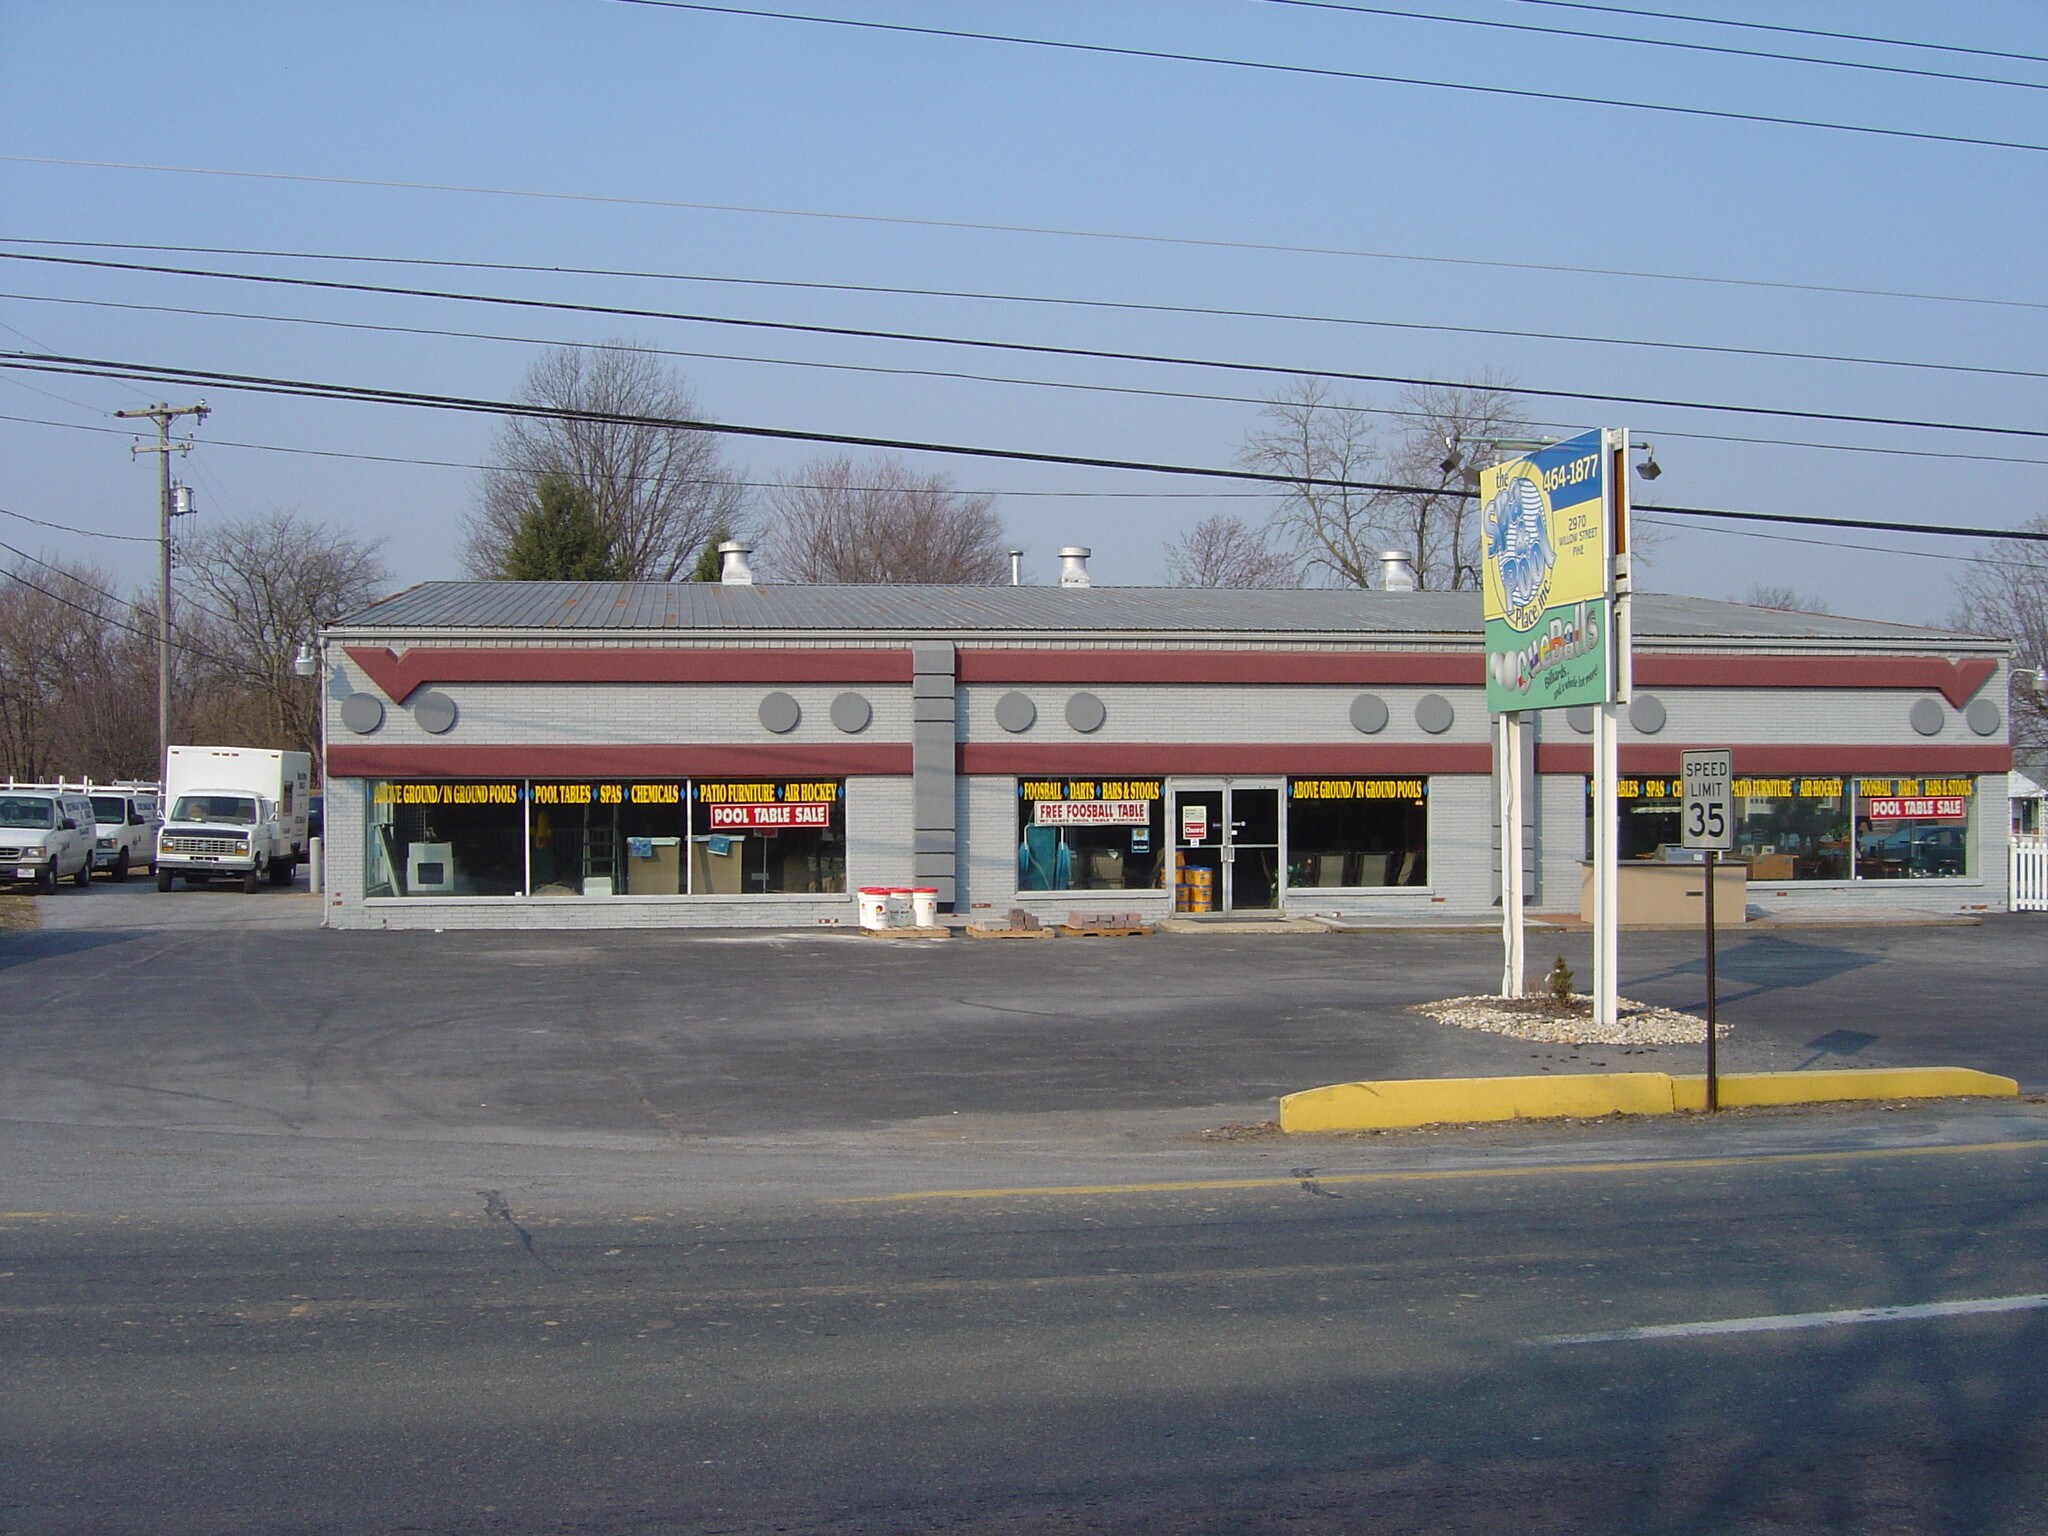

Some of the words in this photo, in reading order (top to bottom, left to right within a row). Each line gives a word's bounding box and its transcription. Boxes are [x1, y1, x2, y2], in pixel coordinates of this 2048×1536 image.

[1495, 466, 1509, 489] the
[1543, 453, 1599, 492] 464-1877
[1568, 514, 1587, 532] 2970
[1559, 533, 1578, 547] WILLOW
[1579, 527, 1598, 542] STREET
[1572, 544, 1585, 557] PIKE
[1686, 761, 1727, 777] SPEED
[453, 784, 488, 804] GROUND
[489, 784, 517, 804] POOLS
[534, 784, 559, 804] POOL
[559, 784, 591, 804] TABLES
[600, 784, 622, 804] SPAS
[631, 784, 679, 804] CHEMICALS
[700, 784, 727, 803] PATIO
[728, 783, 775, 803] FURNITURE
[783, 783, 800, 802] AIR
[800, 783, 837, 802] HOCKEY
[1024, 782, 1062, 800] FOOSBALL
[1069, 782, 1095, 800] DARTS
[1102, 782, 1122, 800] BARS
[1123, 782, 1130, 800] &
[1130, 781, 1159, 800] STOOLS
[1293, 781, 1319, 798] ABOVE
[1365, 781, 1396, 798] GROUND
[1397, 781, 1422, 798] POOLS
[1617, 780, 1639, 797] ABLES
[1645, 780, 1665, 797] SPAS
[1690, 782, 1722, 797] LIMIT
[1731, 780, 1751, 797] PATIO
[1752, 780, 1792, 797] FURNITURE
[1799, 780, 1812, 797] AIR
[1813, 780, 1843, 797] HOCKEY
[1860, 780, 1892, 796] FOOSBALL
[1898, 780, 1919, 796] DARTS
[1924, 780, 1941, 796] BARS
[1948, 780, 1972, 796] STOOLS
[714, 808, 749, 823] POOL
[754, 807, 790, 823] TABLE
[795, 806, 825, 822] SALE
[1040, 804, 1062, 818] FREE
[1066, 804, 1113, 818] FOOSBALL
[1118, 803, 1144, 818] TABLE
[1872, 801, 1900, 816] POOL
[1904, 801, 1933, 816] TABLE
[1937, 800, 1960, 815] SALE
[1688, 802, 1724, 838] 35
